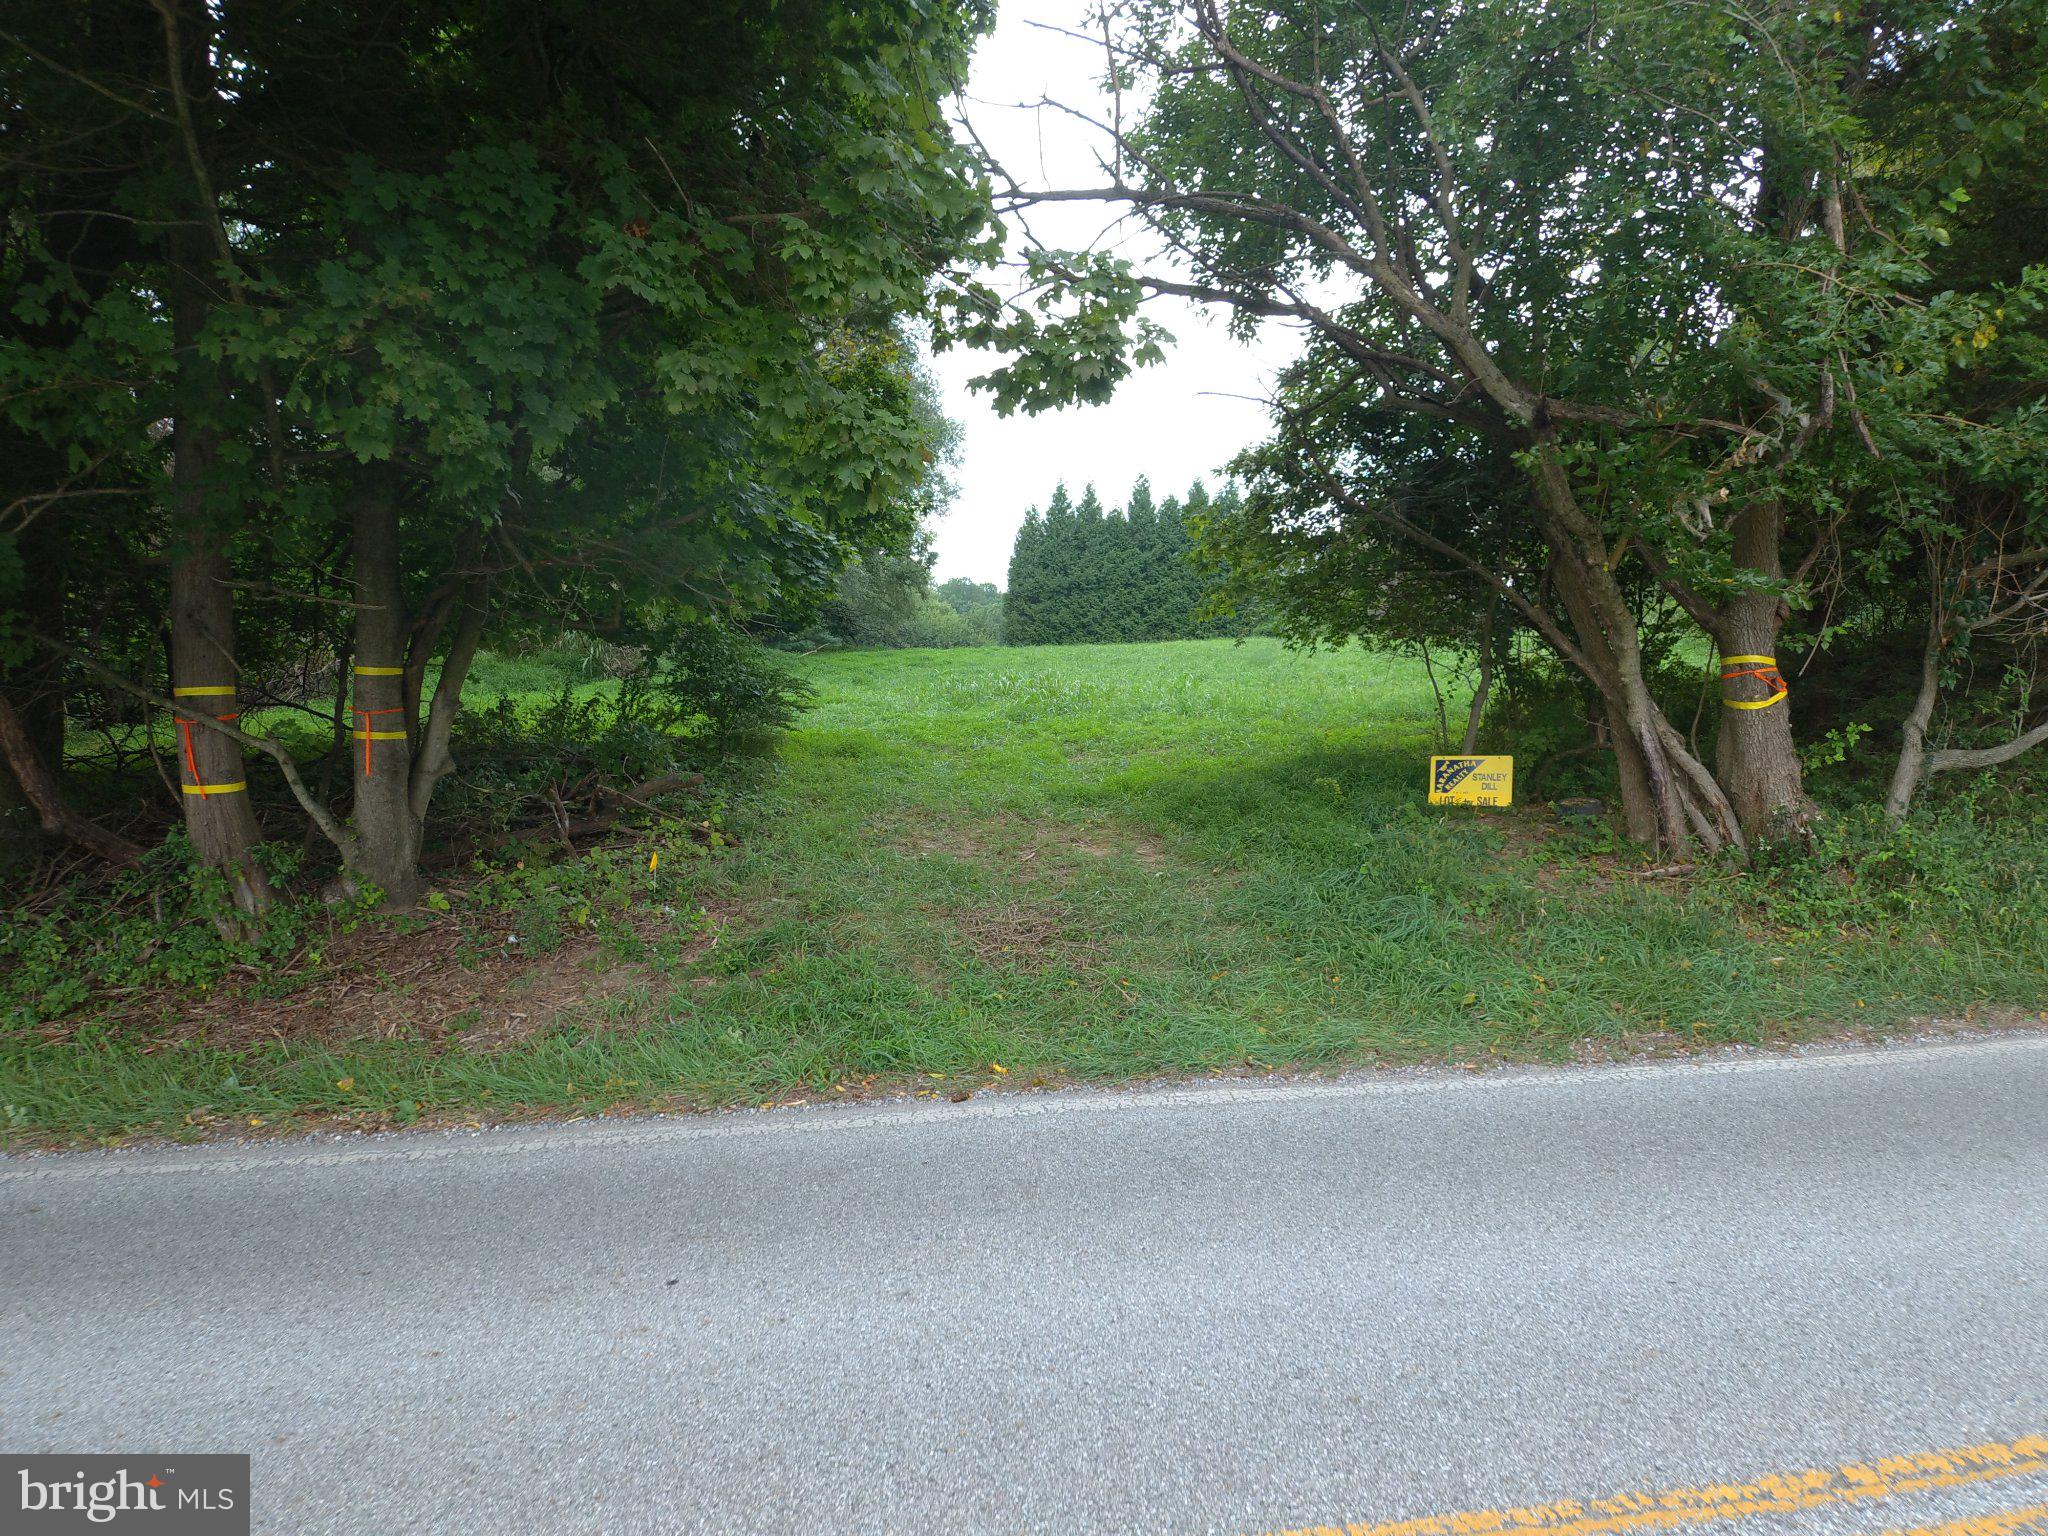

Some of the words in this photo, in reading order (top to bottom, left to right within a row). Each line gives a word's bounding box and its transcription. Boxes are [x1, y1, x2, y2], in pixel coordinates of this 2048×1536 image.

[1444, 769, 1469, 790] REALTY
[1472, 773, 1507, 781] STANLEY
[1482, 782, 1497, 790] DILL
